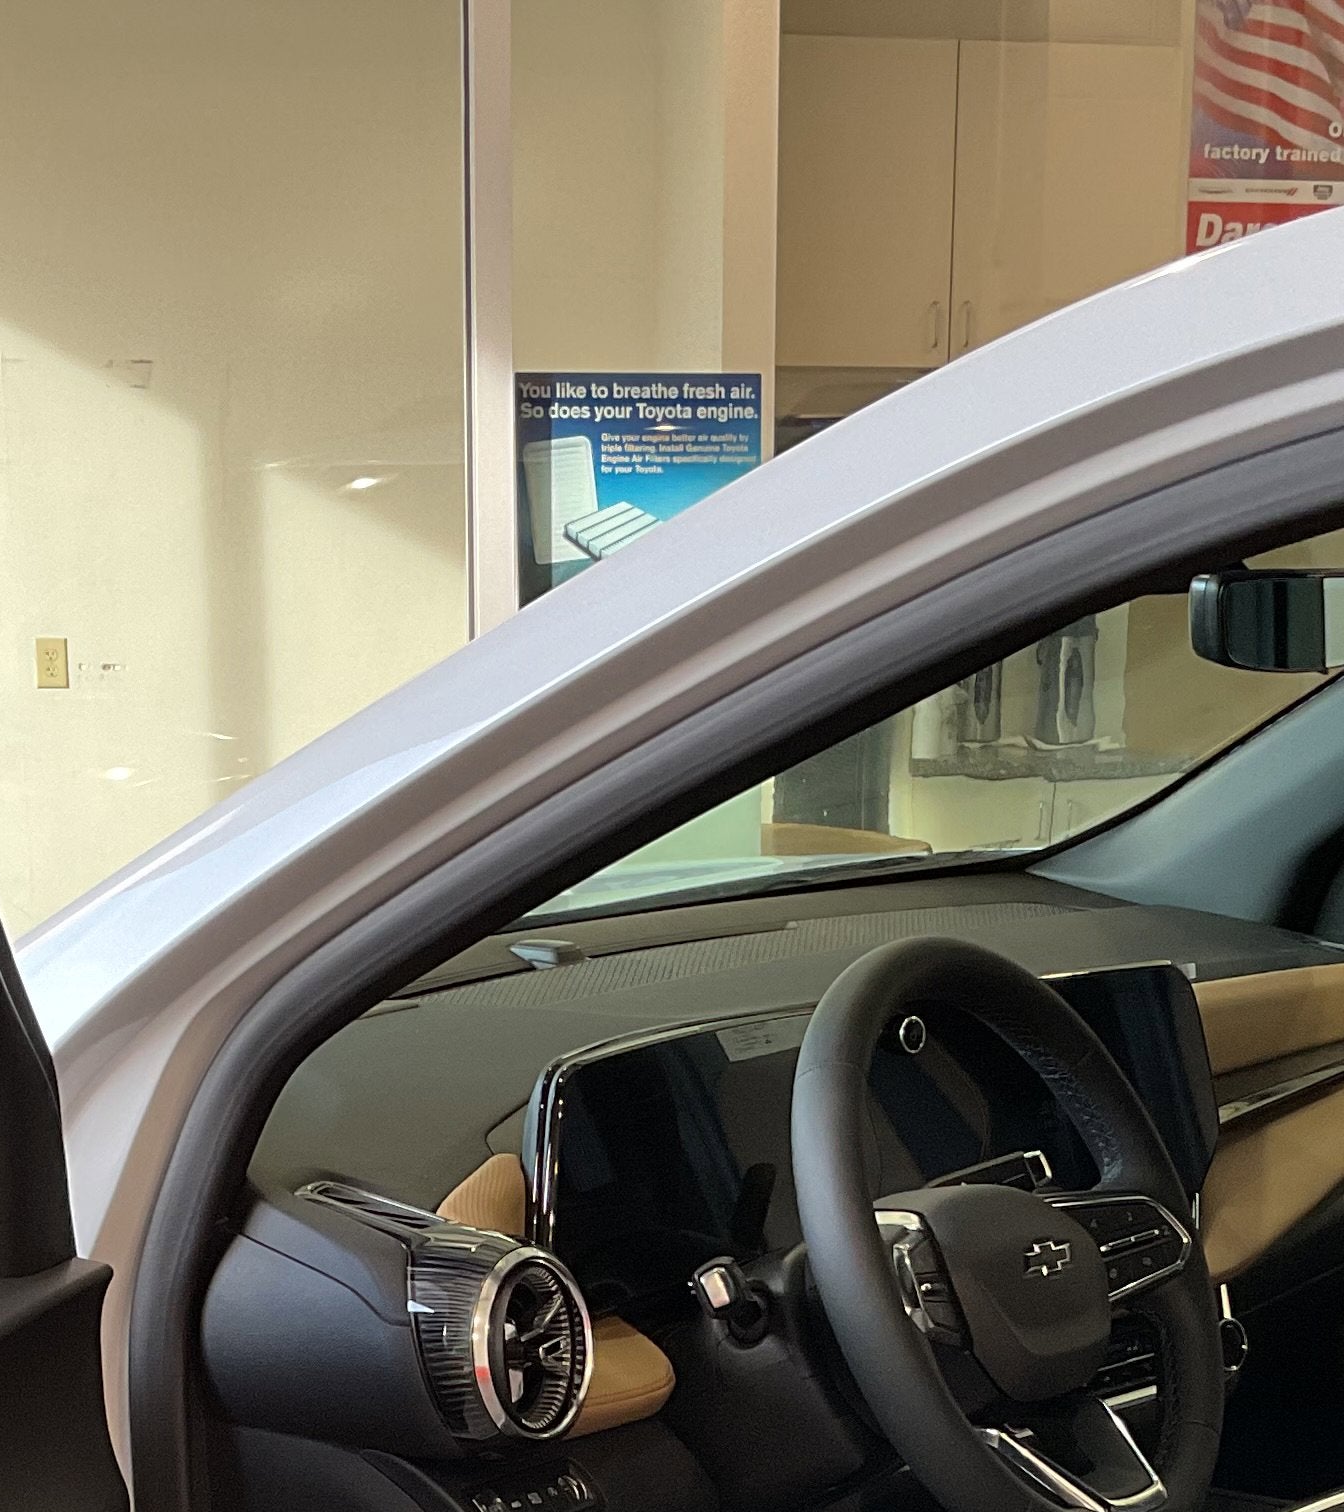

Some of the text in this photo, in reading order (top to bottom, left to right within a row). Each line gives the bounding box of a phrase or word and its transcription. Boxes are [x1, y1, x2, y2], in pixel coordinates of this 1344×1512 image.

[1204, 144, 1270, 164] factory
[1275, 145, 1340, 163] trained
[519, 382, 756, 399] You like to breathe fresh air.
[519, 402, 758, 423] So does your Toyota engine.
